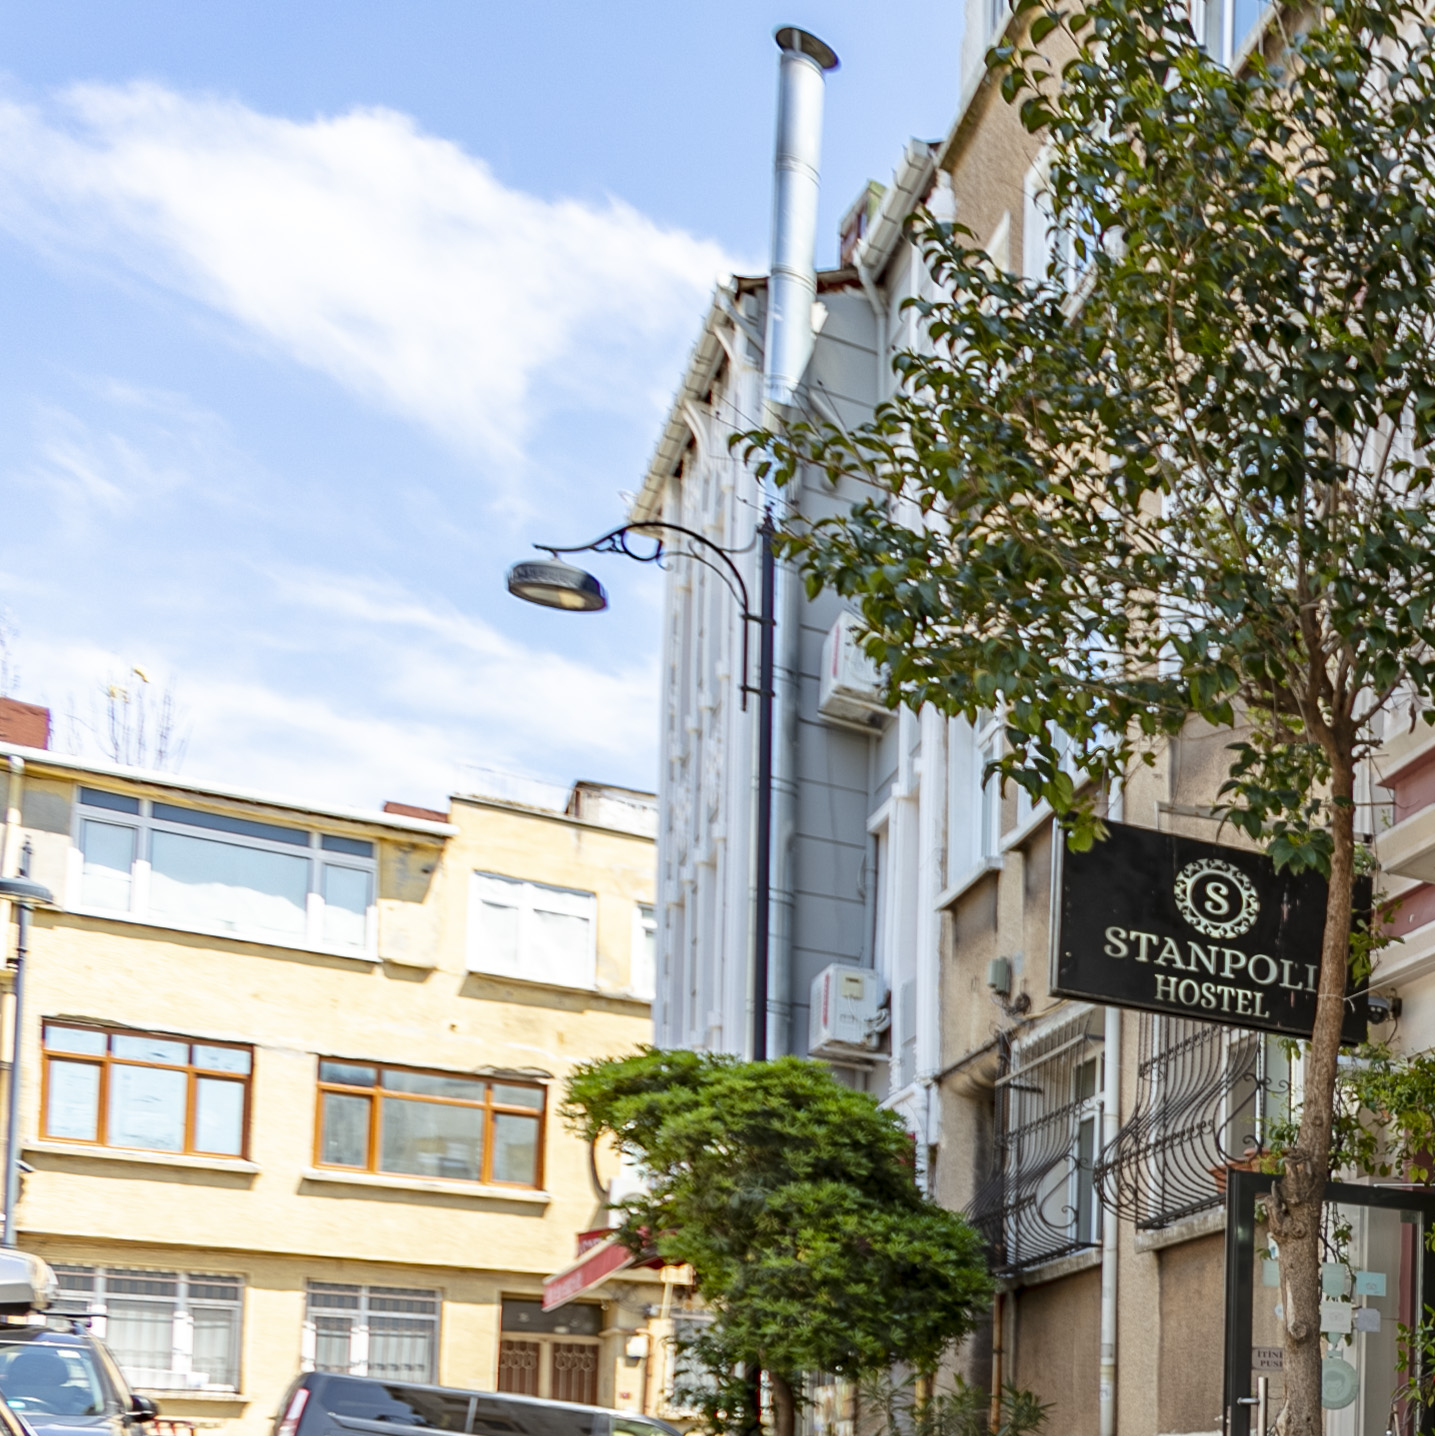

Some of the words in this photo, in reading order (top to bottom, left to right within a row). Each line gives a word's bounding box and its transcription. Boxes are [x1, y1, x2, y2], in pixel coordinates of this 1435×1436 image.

[1203, 881, 1230, 916] S
[1103, 926, 1319, 993] STANPOLI
[1154, 973, 1271, 1019] HOSTEL
